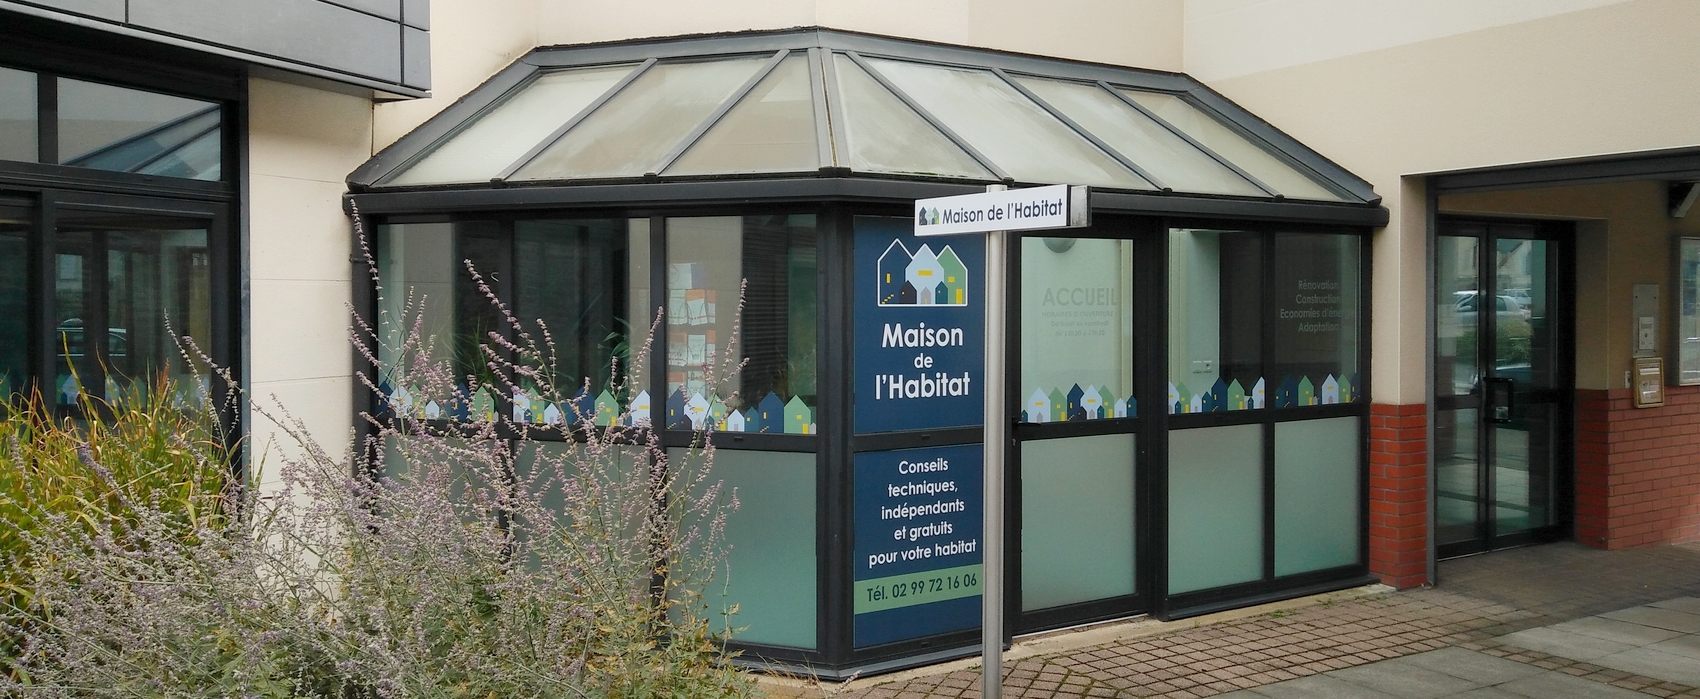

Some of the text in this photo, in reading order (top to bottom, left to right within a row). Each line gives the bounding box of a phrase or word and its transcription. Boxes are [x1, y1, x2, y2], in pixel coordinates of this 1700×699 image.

[943, 206, 983, 224] Maison
[987, 204, 1003, 221] de
[1298, 279, 1339, 290] Rénovation
[1042, 287, 1118, 306] ACCUEIL
[1295, 293, 1341, 304] Construction
[1280, 308, 1320, 319] Economies
[882, 321, 963, 348] Maison
[1298, 321, 1339, 334] Adaptation
[913, 353, 934, 369] de
[898, 457, 949, 475] Conseils
[887, 480, 959, 497] techniques,
[881, 498, 965, 520] indépendants
[893, 521, 953, 542] et gratuits
[868, 539, 977, 569] pour votre habitat
[867, 572, 977, 602] Tél. 02 99 72 16 06
